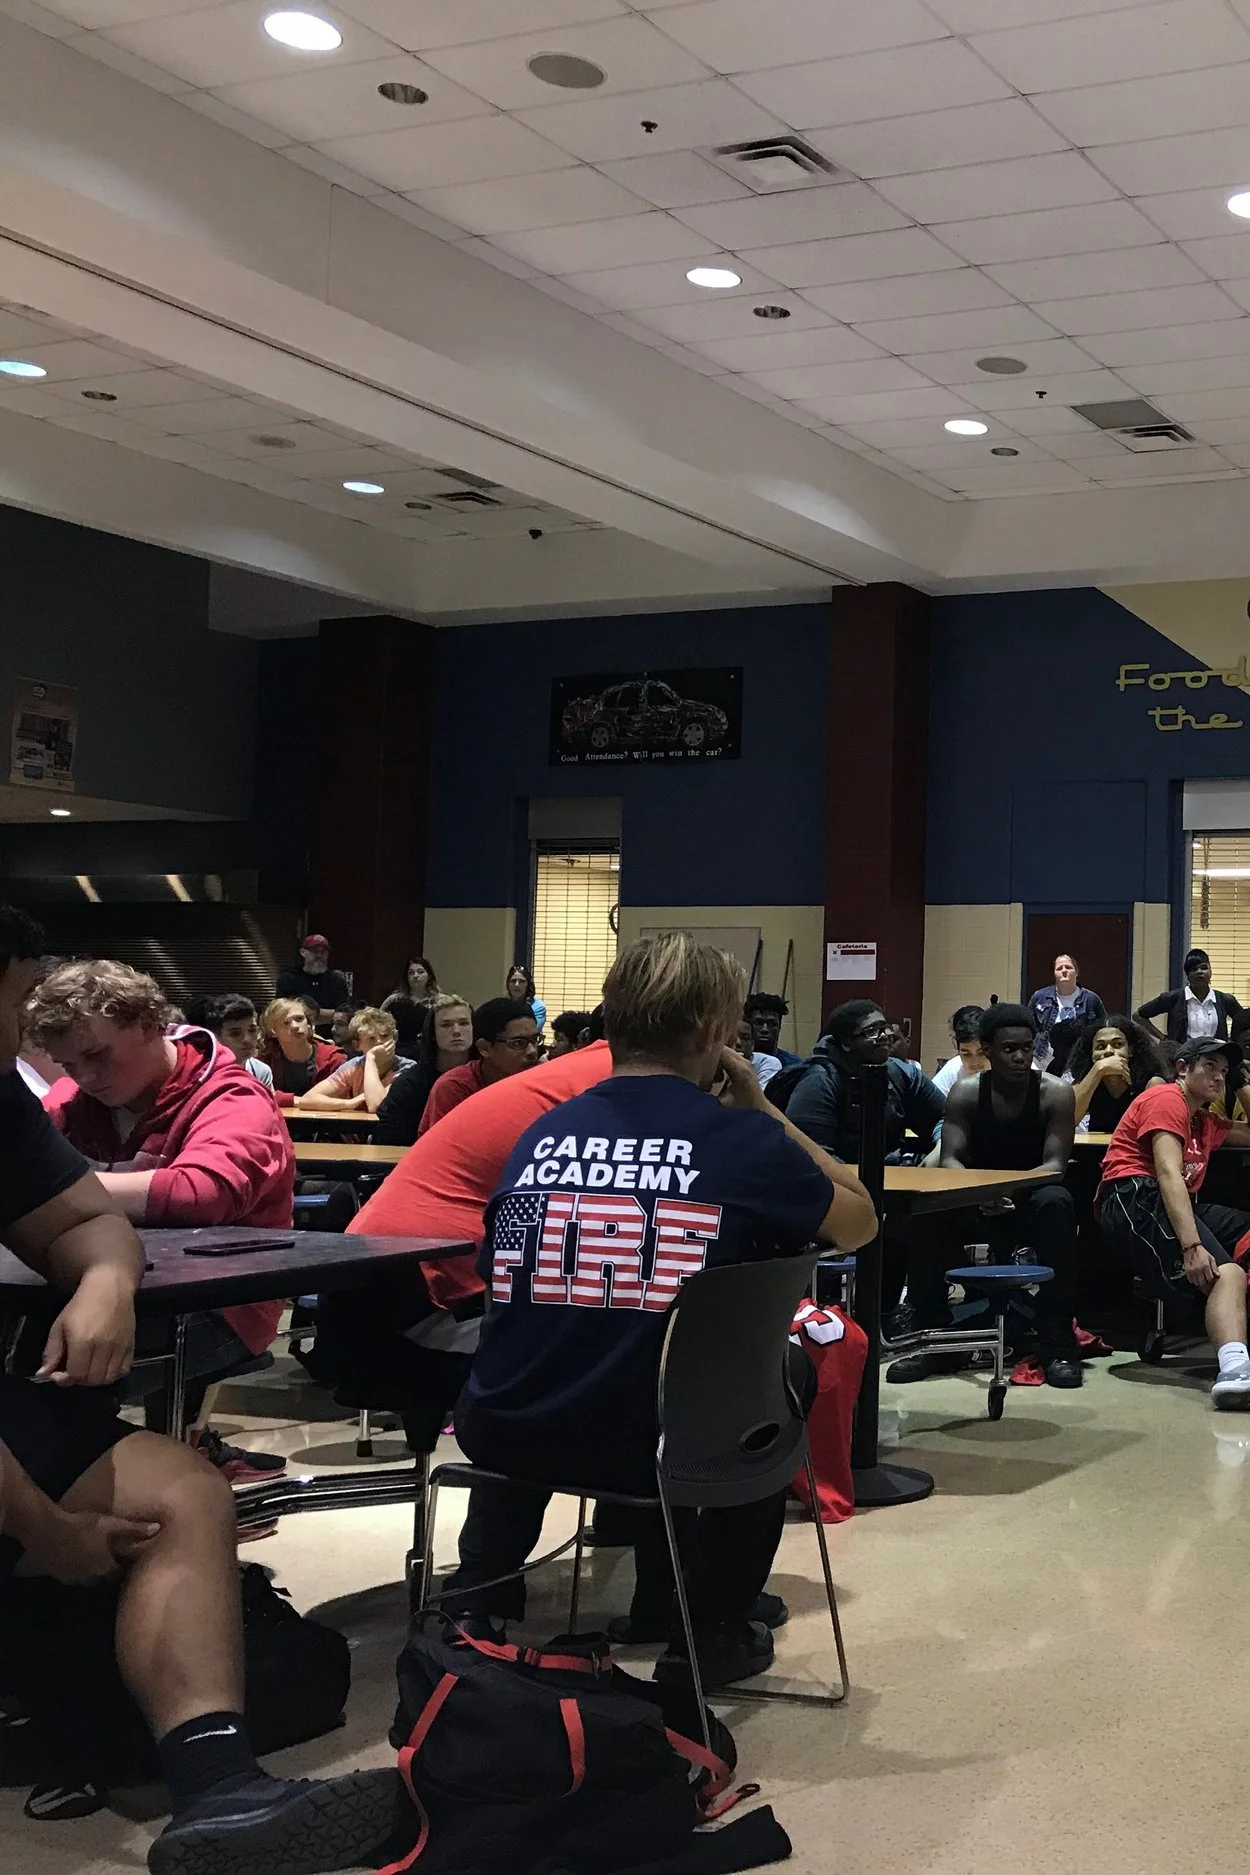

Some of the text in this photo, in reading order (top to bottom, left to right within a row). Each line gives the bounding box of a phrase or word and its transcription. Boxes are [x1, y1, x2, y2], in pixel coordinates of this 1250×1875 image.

[1147, 705, 1244, 731] the
[560, 754, 579, 762] Good
[584, 751, 629, 761] Attendance?
[632, 751, 649, 760] Will
[651, 751, 665, 760] you
[687, 749, 700, 757] the
[705, 748, 723, 756] car?
[533, 1135, 694, 1166] CAREER
[513, 1160, 701, 1194] ACADEMY
[491, 1190, 724, 1313] FIRE
